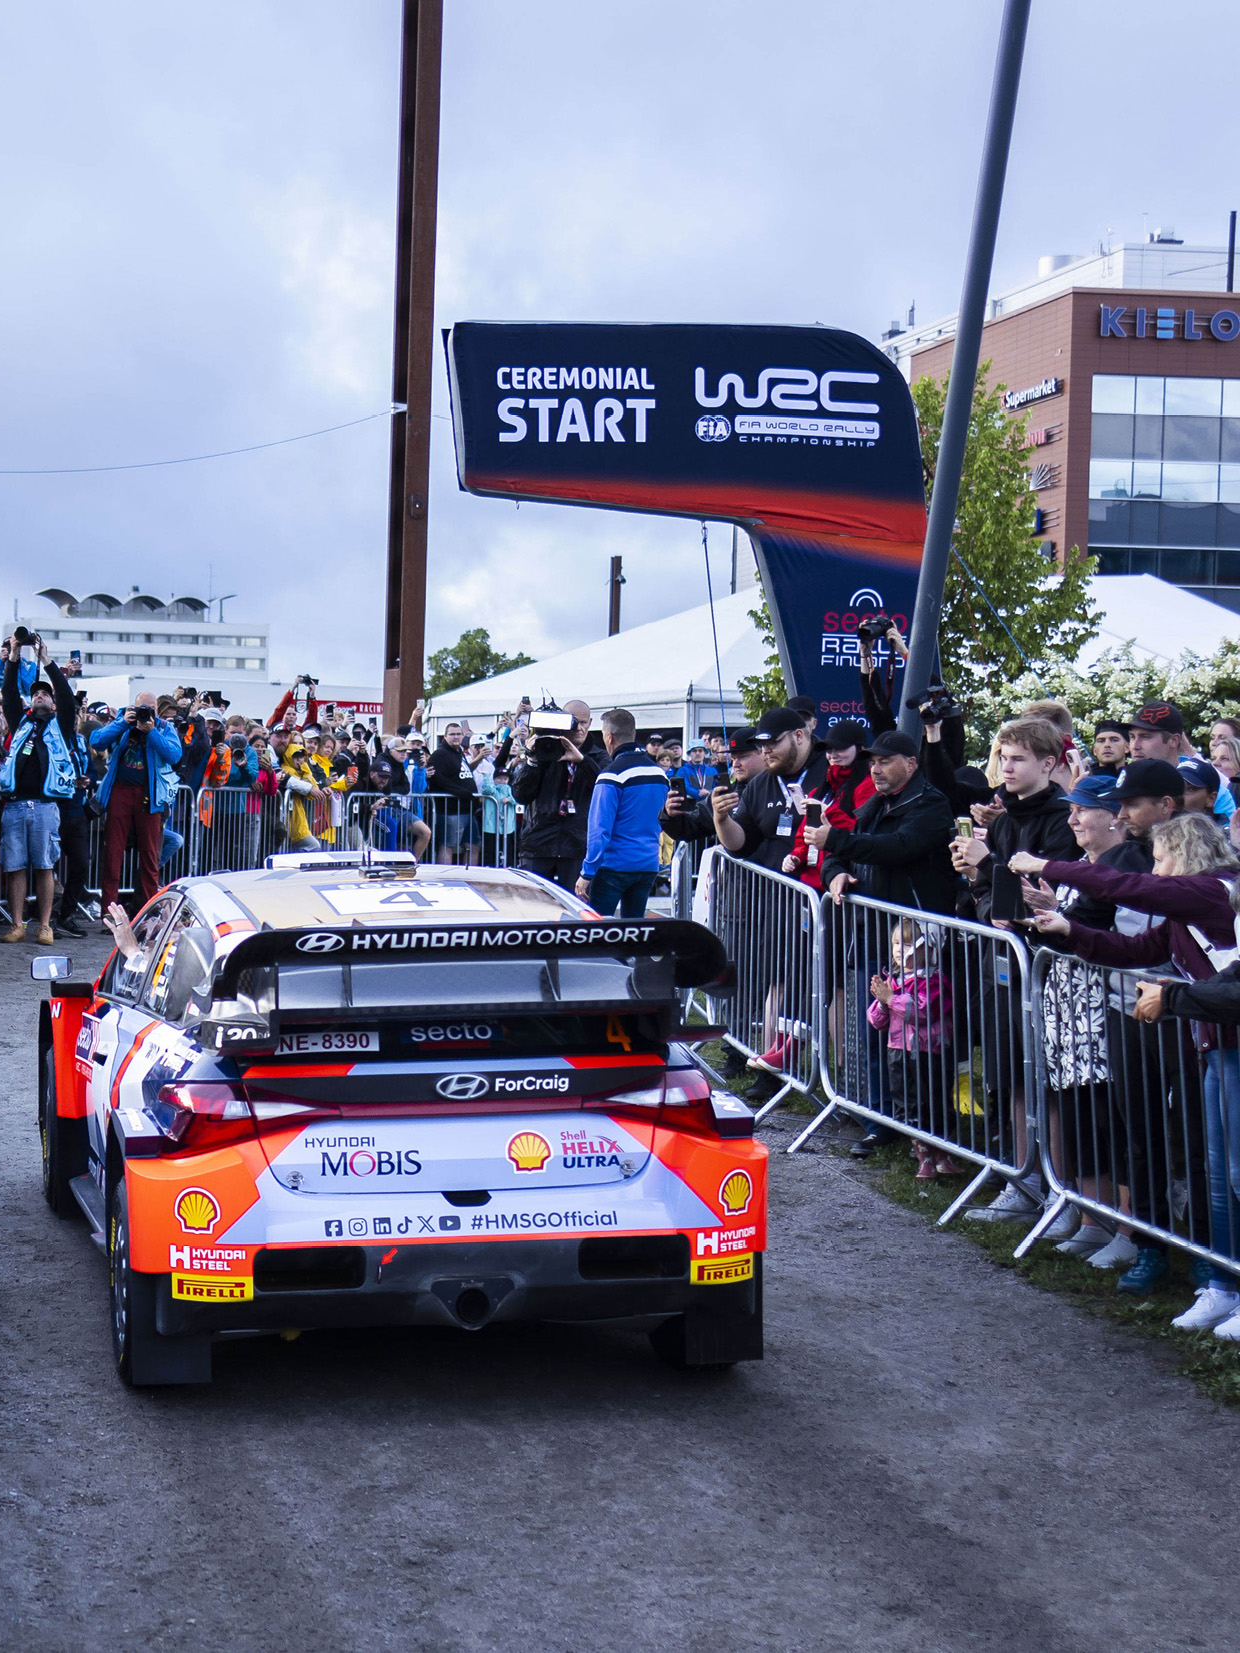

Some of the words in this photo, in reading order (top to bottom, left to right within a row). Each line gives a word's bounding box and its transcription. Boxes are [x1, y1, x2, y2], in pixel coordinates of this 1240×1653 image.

[1100, 306, 1240, 342] KIELO
[497, 367, 655, 390] CEREMONIAL
[695, 367, 880, 413] WRC
[498, 399, 656, 442] START
[766, 422, 819, 432] WORLD
[824, 424, 876, 435] RALLY
[739, 436, 876, 448] CHAMPIONSHIP
[823, 610, 908, 633] seo
[359, 704, 383, 713] RACIN
[380, 891, 439, 907] 4
[352, 932, 477, 950] HYUNDAI
[482, 927, 655, 946] MOTORSPORT
[411, 1022, 492, 1042] secto
[607, 1014, 632, 1052] 4
[279, 1033, 370, 1052] NE-8390
[495, 1075, 569, 1092] ForCraig
[305, 1137, 375, 1148] HYUNDAI
[560, 1130, 586, 1141] Shell
[562, 1139, 624, 1155] HELIX
[321, 1150, 422, 1177] MOBIS
[563, 1154, 620, 1169] ULTRA
[471, 1211, 618, 1230] #HMSGOfficial
[720, 1226, 756, 1240] HYUNDAI
[192, 1248, 246, 1260] HYUNDAI
[720, 1239, 747, 1252] STEEL
[192, 1260, 231, 1271] STEEL
[697, 1259, 751, 1281] PIRELLI
[177, 1279, 246, 1298] PIRELLI
